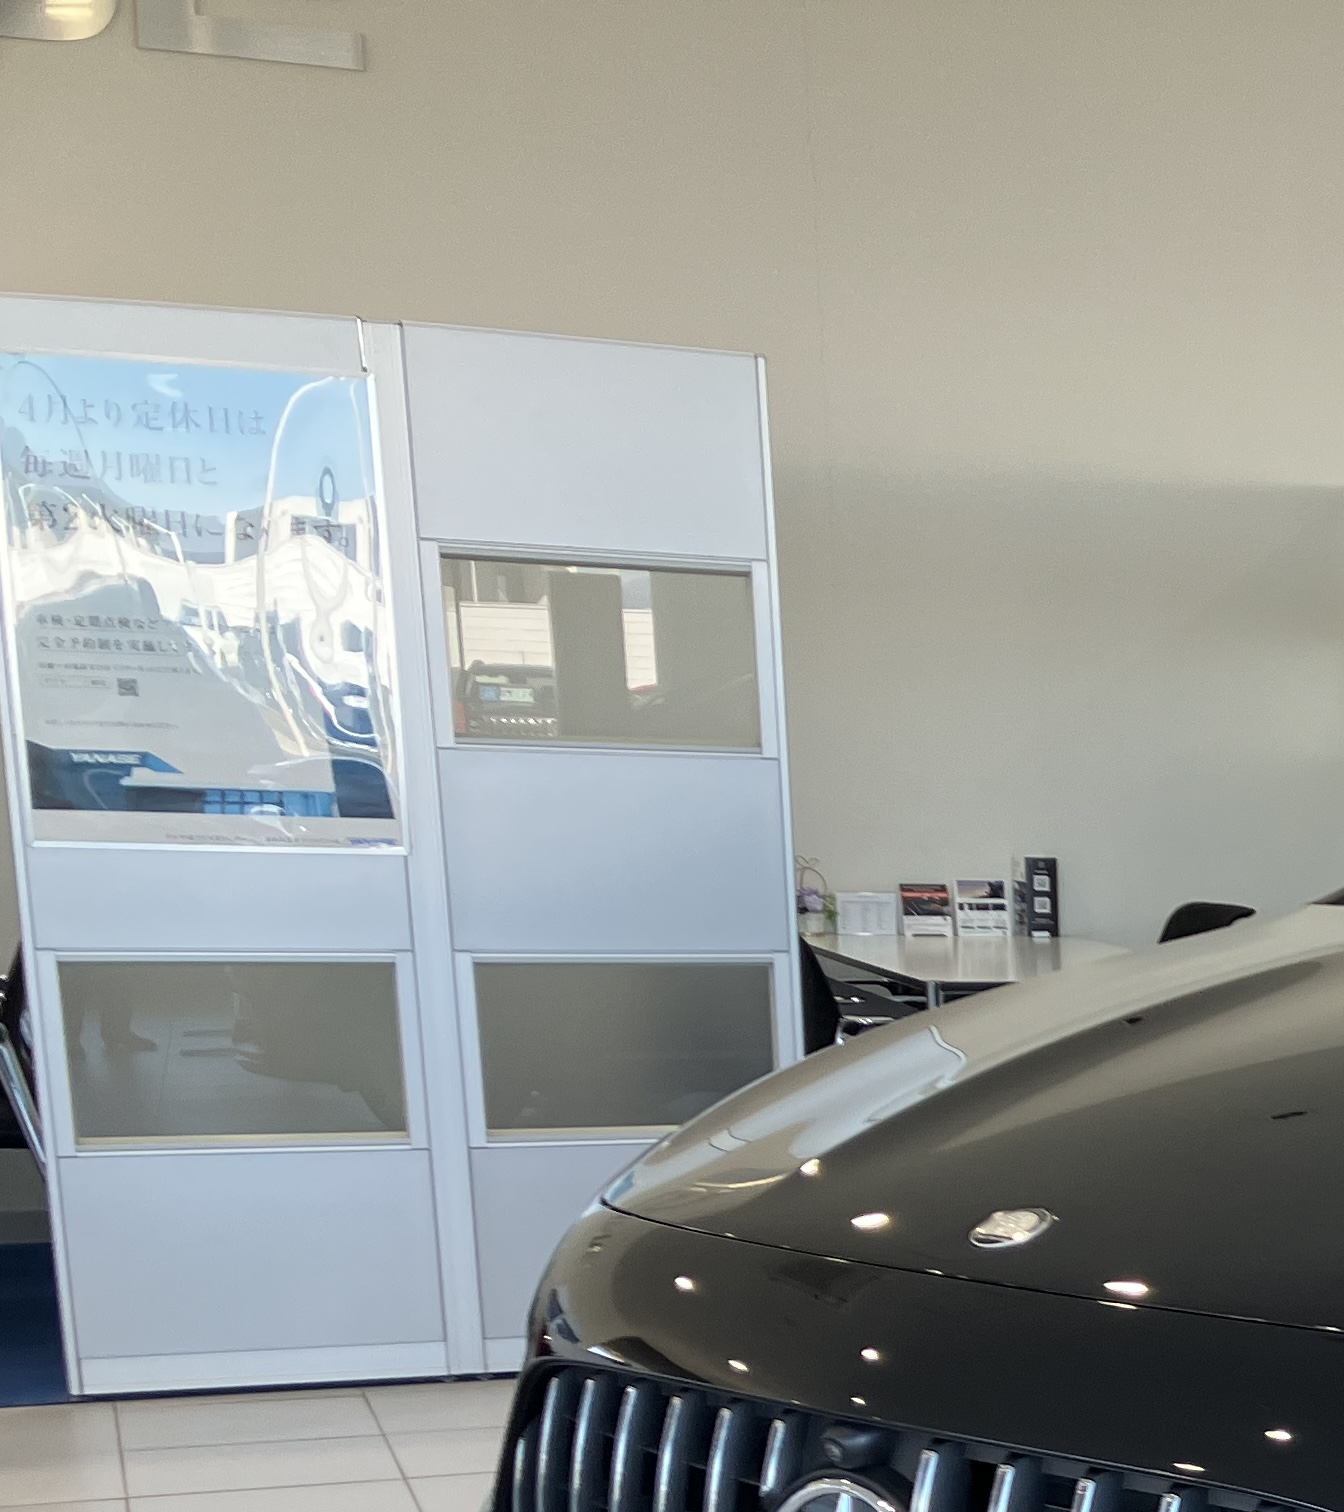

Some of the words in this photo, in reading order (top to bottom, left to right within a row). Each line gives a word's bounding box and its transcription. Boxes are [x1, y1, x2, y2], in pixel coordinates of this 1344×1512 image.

[18, 393, 266, 436] 4月より定休日は
[21, 444, 220, 486] 毎週月曜日と
